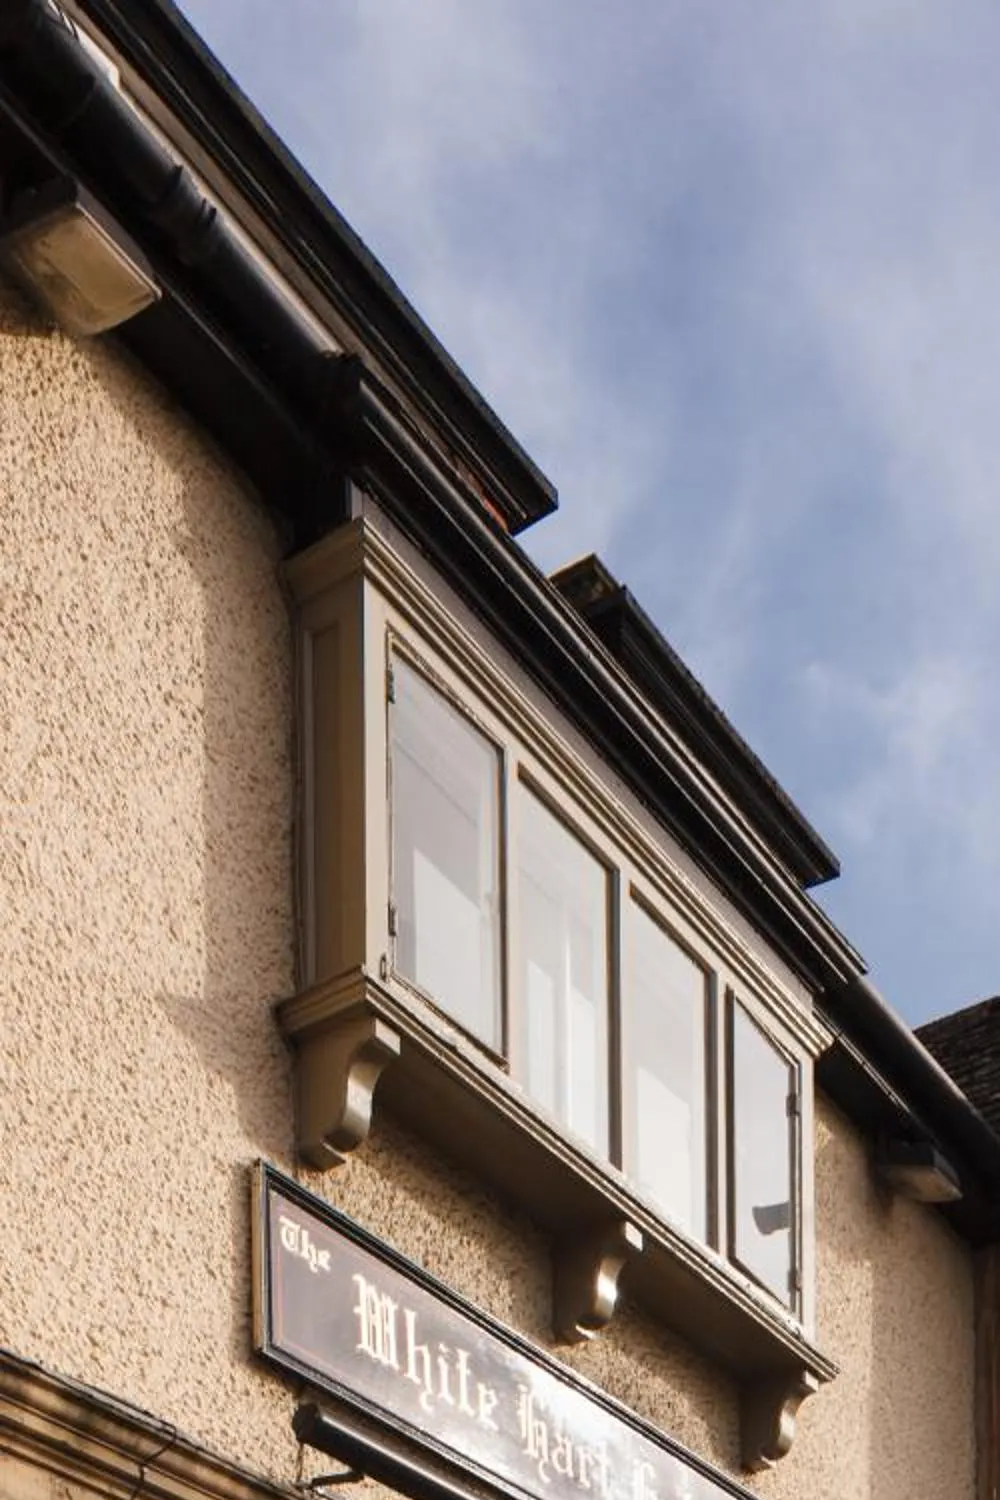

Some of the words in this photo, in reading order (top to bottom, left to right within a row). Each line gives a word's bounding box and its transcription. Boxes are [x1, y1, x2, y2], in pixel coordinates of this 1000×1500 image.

[279, 1215, 331, 1271] The
[353, 1272, 498, 1426] White
[516, 1384, 608, 1493] Hart
